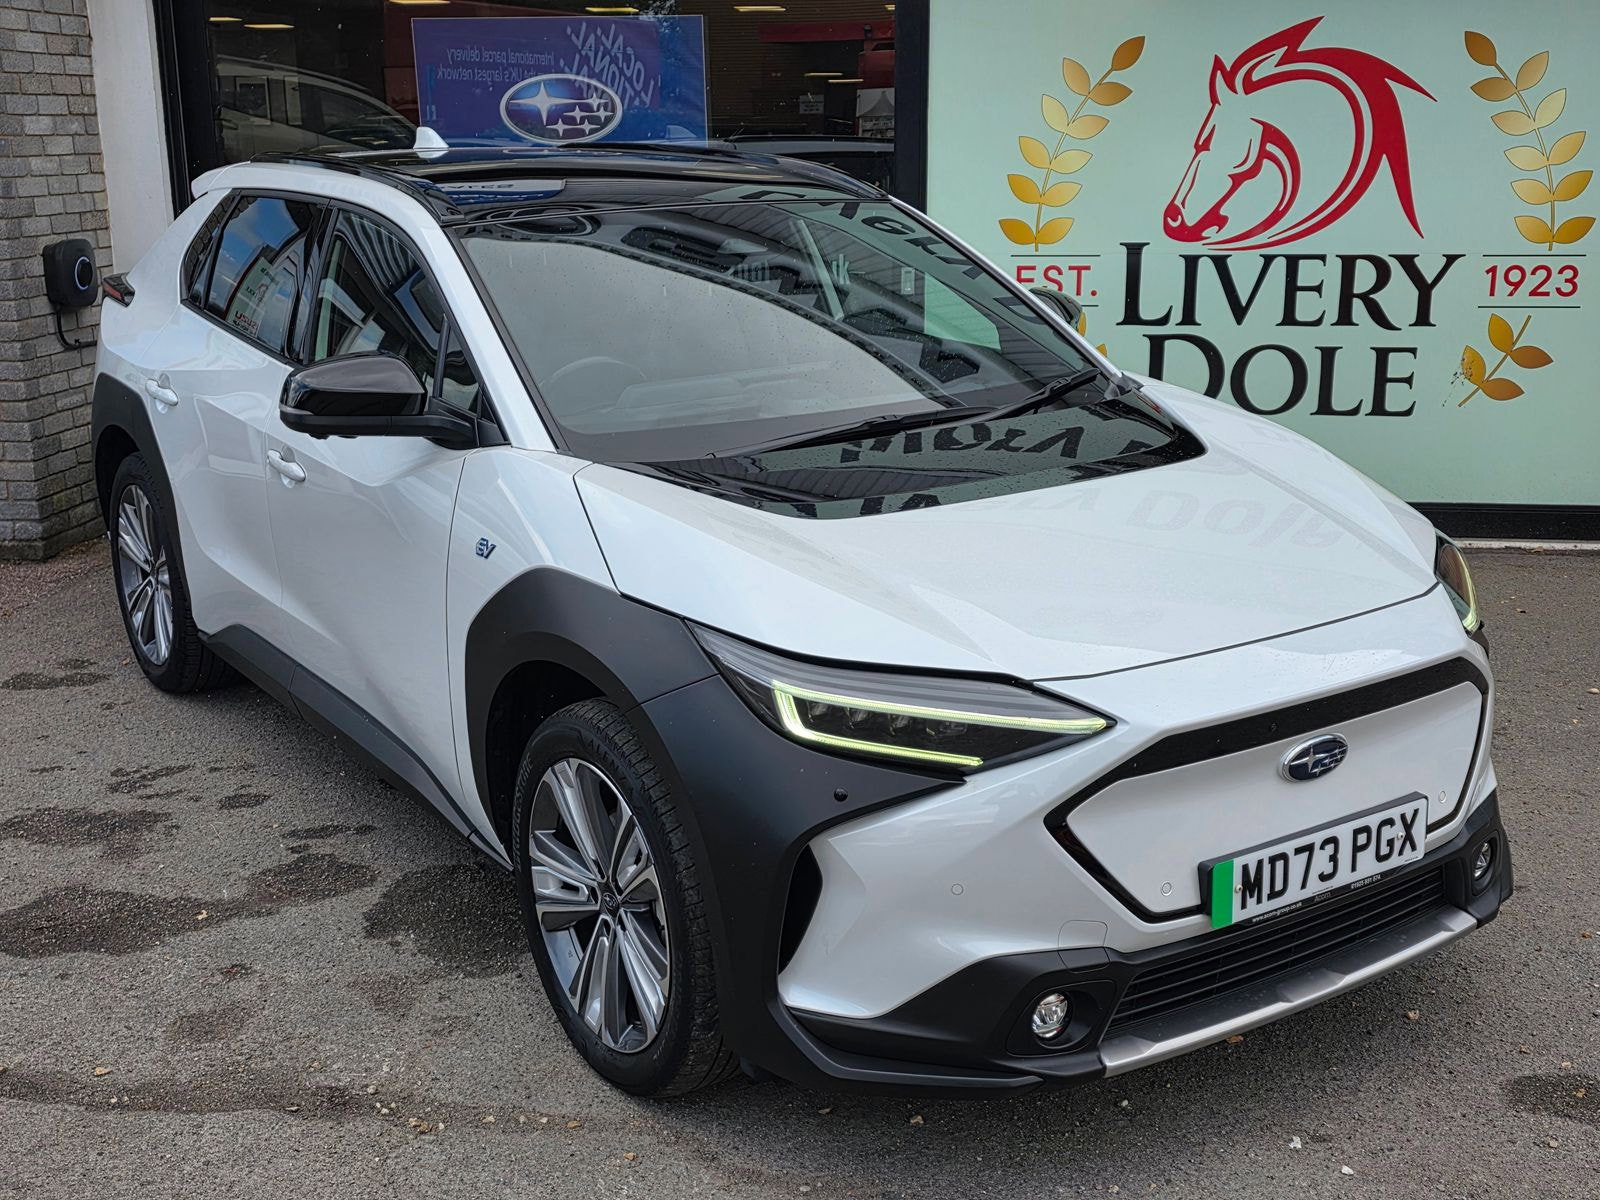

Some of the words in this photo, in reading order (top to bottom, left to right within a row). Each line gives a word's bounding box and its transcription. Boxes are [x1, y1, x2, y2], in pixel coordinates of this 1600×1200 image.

[1016, 265, 1098, 297] EST.
[1116, 242, 1466, 331] LIVERY
[1485, 264, 1579, 297] 1923
[1143, 334, 1418, 417] DOLE
[1240, 835, 1340, 910] MD73
[1351, 808, 1420, 873] PGX
